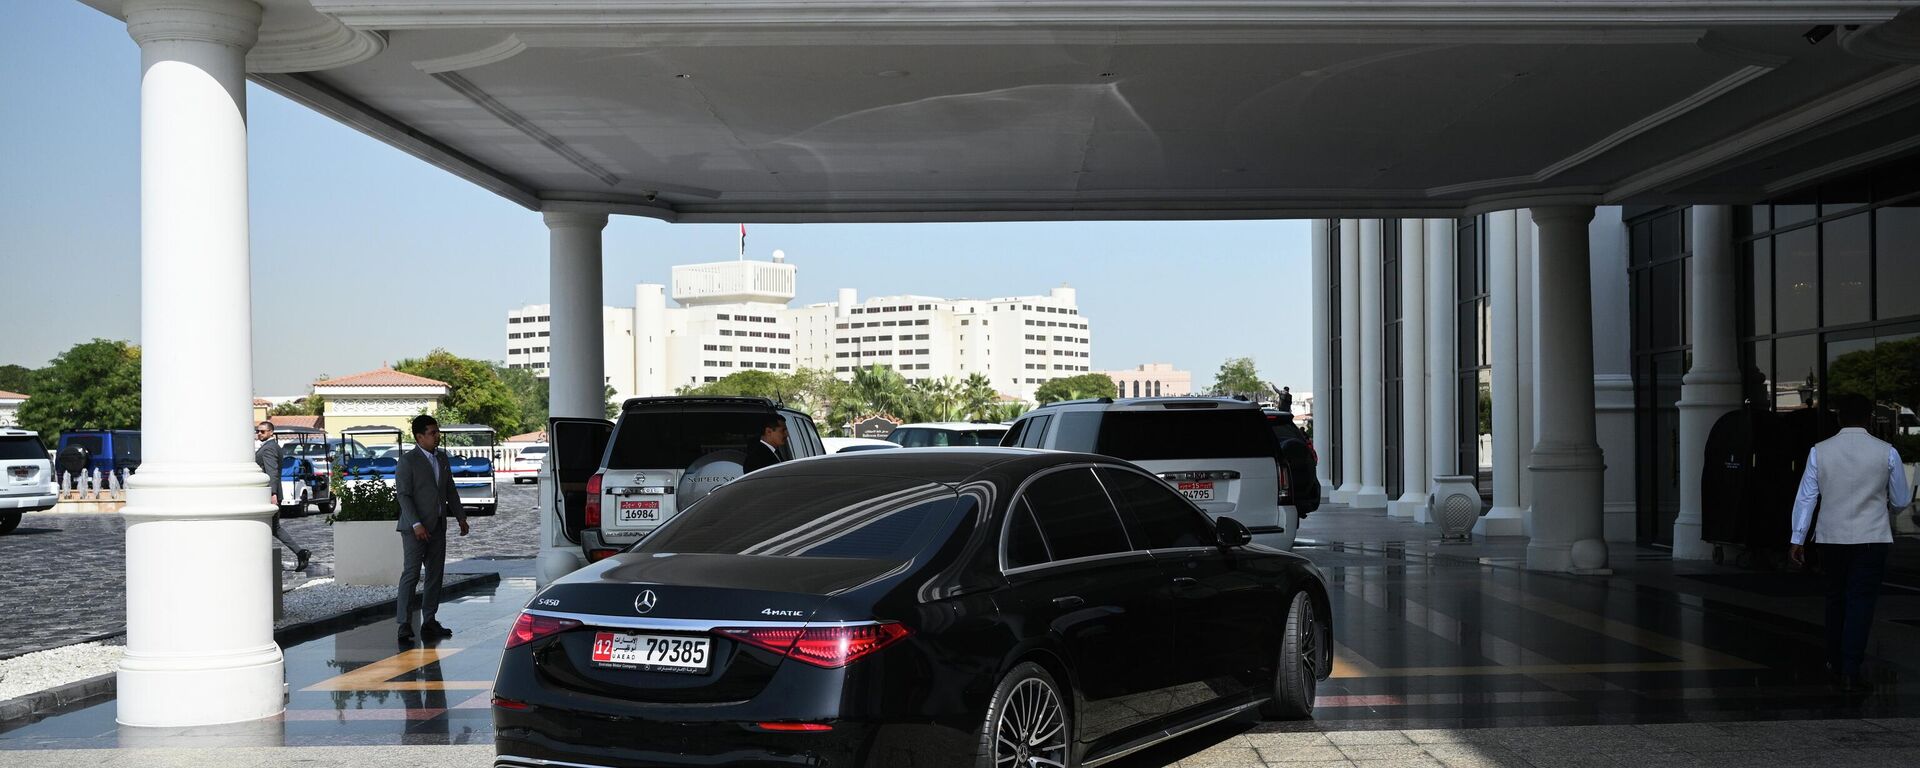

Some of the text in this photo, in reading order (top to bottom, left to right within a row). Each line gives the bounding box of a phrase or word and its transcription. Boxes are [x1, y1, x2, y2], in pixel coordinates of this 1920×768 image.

[625, 509, 654, 519] 16984
[761, 608, 804, 617] 4MATIC
[595, 639, 611, 655] 12
[646, 638, 706, 664] 79385
